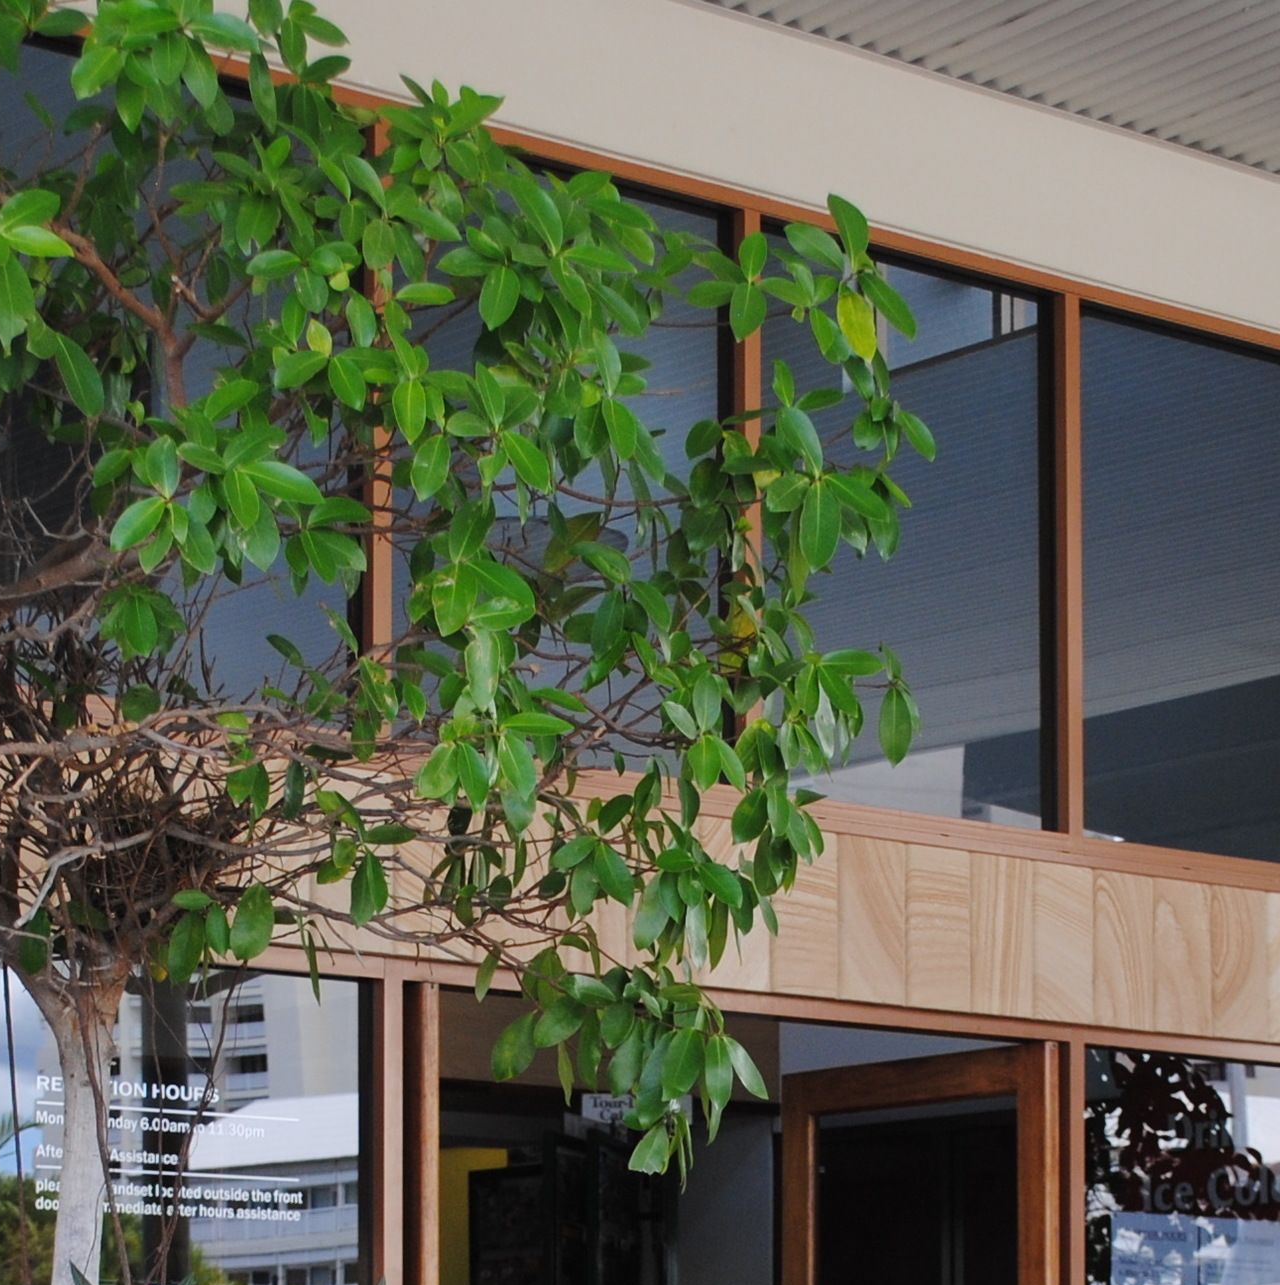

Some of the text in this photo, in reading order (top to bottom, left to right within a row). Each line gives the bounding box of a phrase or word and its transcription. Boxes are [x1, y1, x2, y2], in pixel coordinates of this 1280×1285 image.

[36, 1144, 64, 1159] Afte
[203, 1186, 249, 1202] outside
[251, 1187, 271, 1203] the
[273, 1189, 304, 1205] front
[199, 1204, 235, 1219] hours
[236, 1206, 301, 1222] assistance
